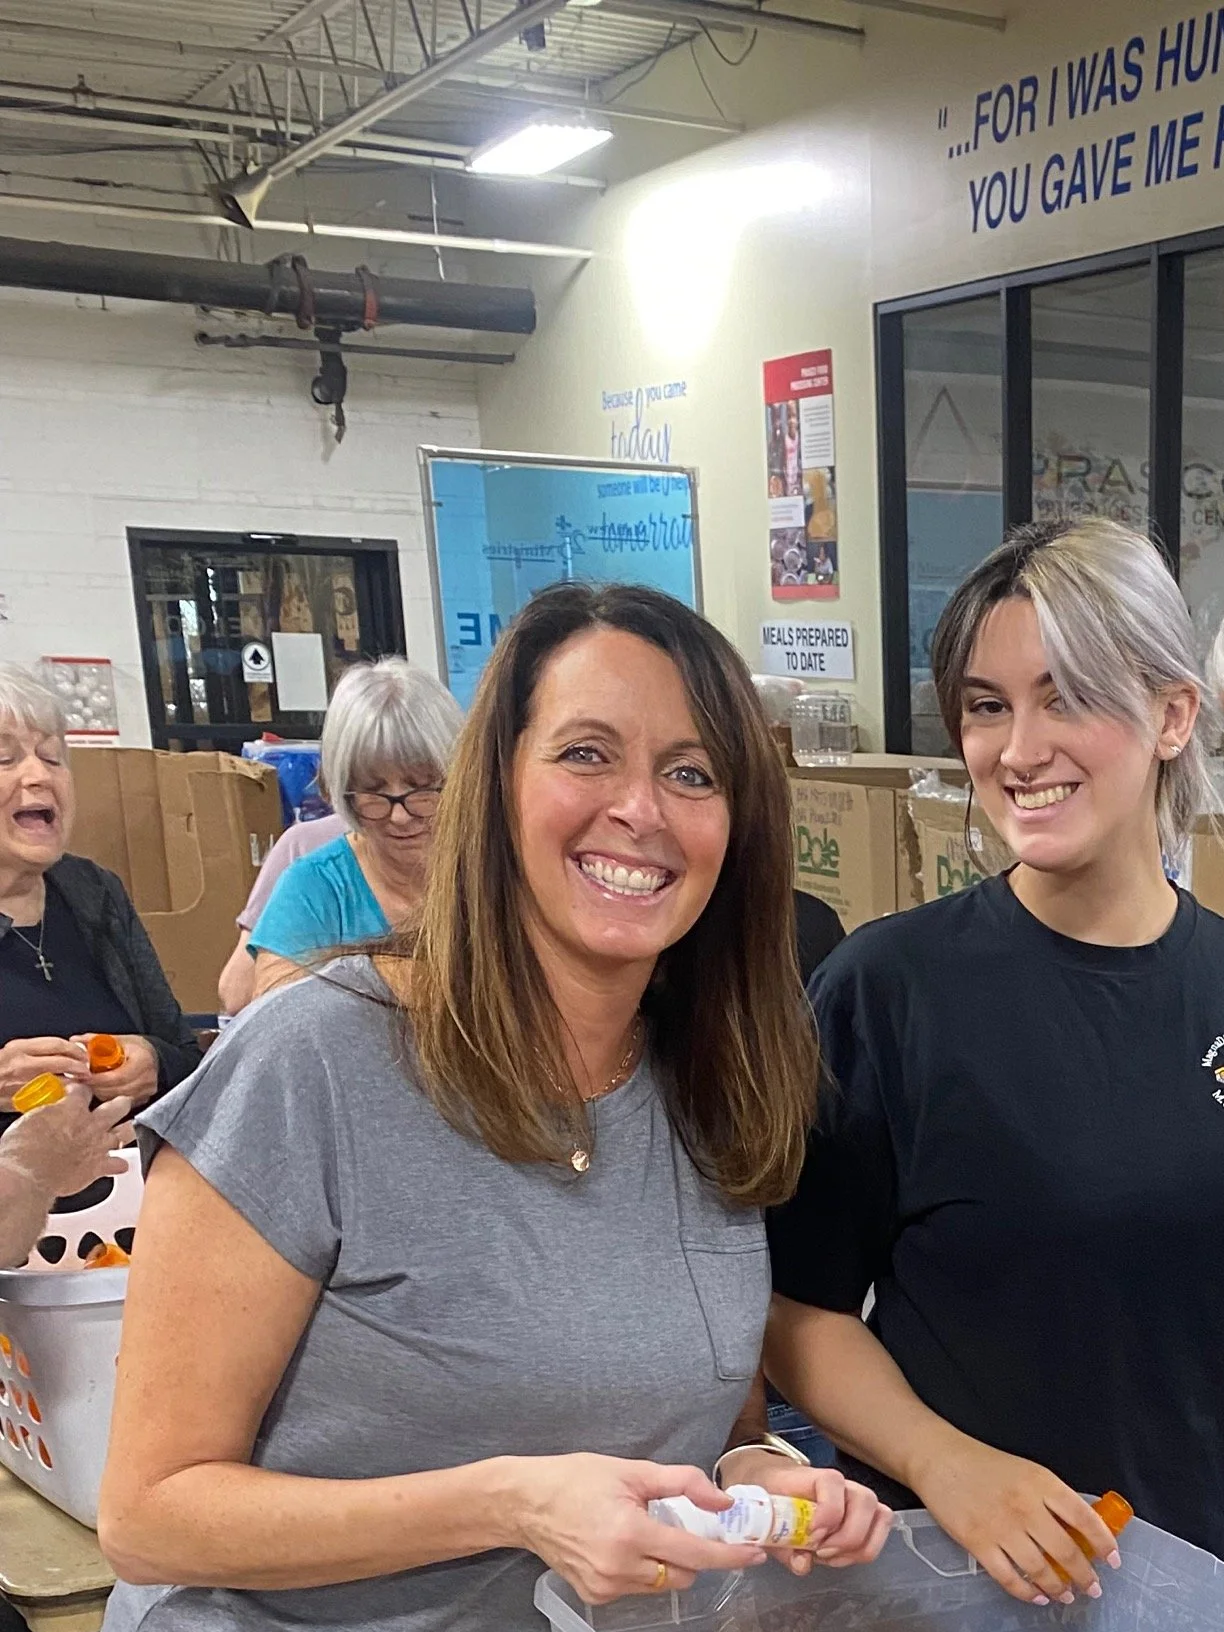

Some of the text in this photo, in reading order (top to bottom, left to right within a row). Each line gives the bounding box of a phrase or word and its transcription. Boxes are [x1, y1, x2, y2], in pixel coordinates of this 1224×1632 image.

[1047, 67, 1057, 127] I
[1068, 36, 1146, 121] WAS
[968, 157, 1031, 233] YOU
[1040, 132, 1136, 216] GAVE
[1145, 113, 1204, 188] ME
[602, 380, 687, 411] Because you came
[611, 387, 671, 464] today
[763, 626, 849, 647] MEALS PREPARED
[785, 651, 826, 672] TO DATE
[796, 825, 841, 869] Dole
